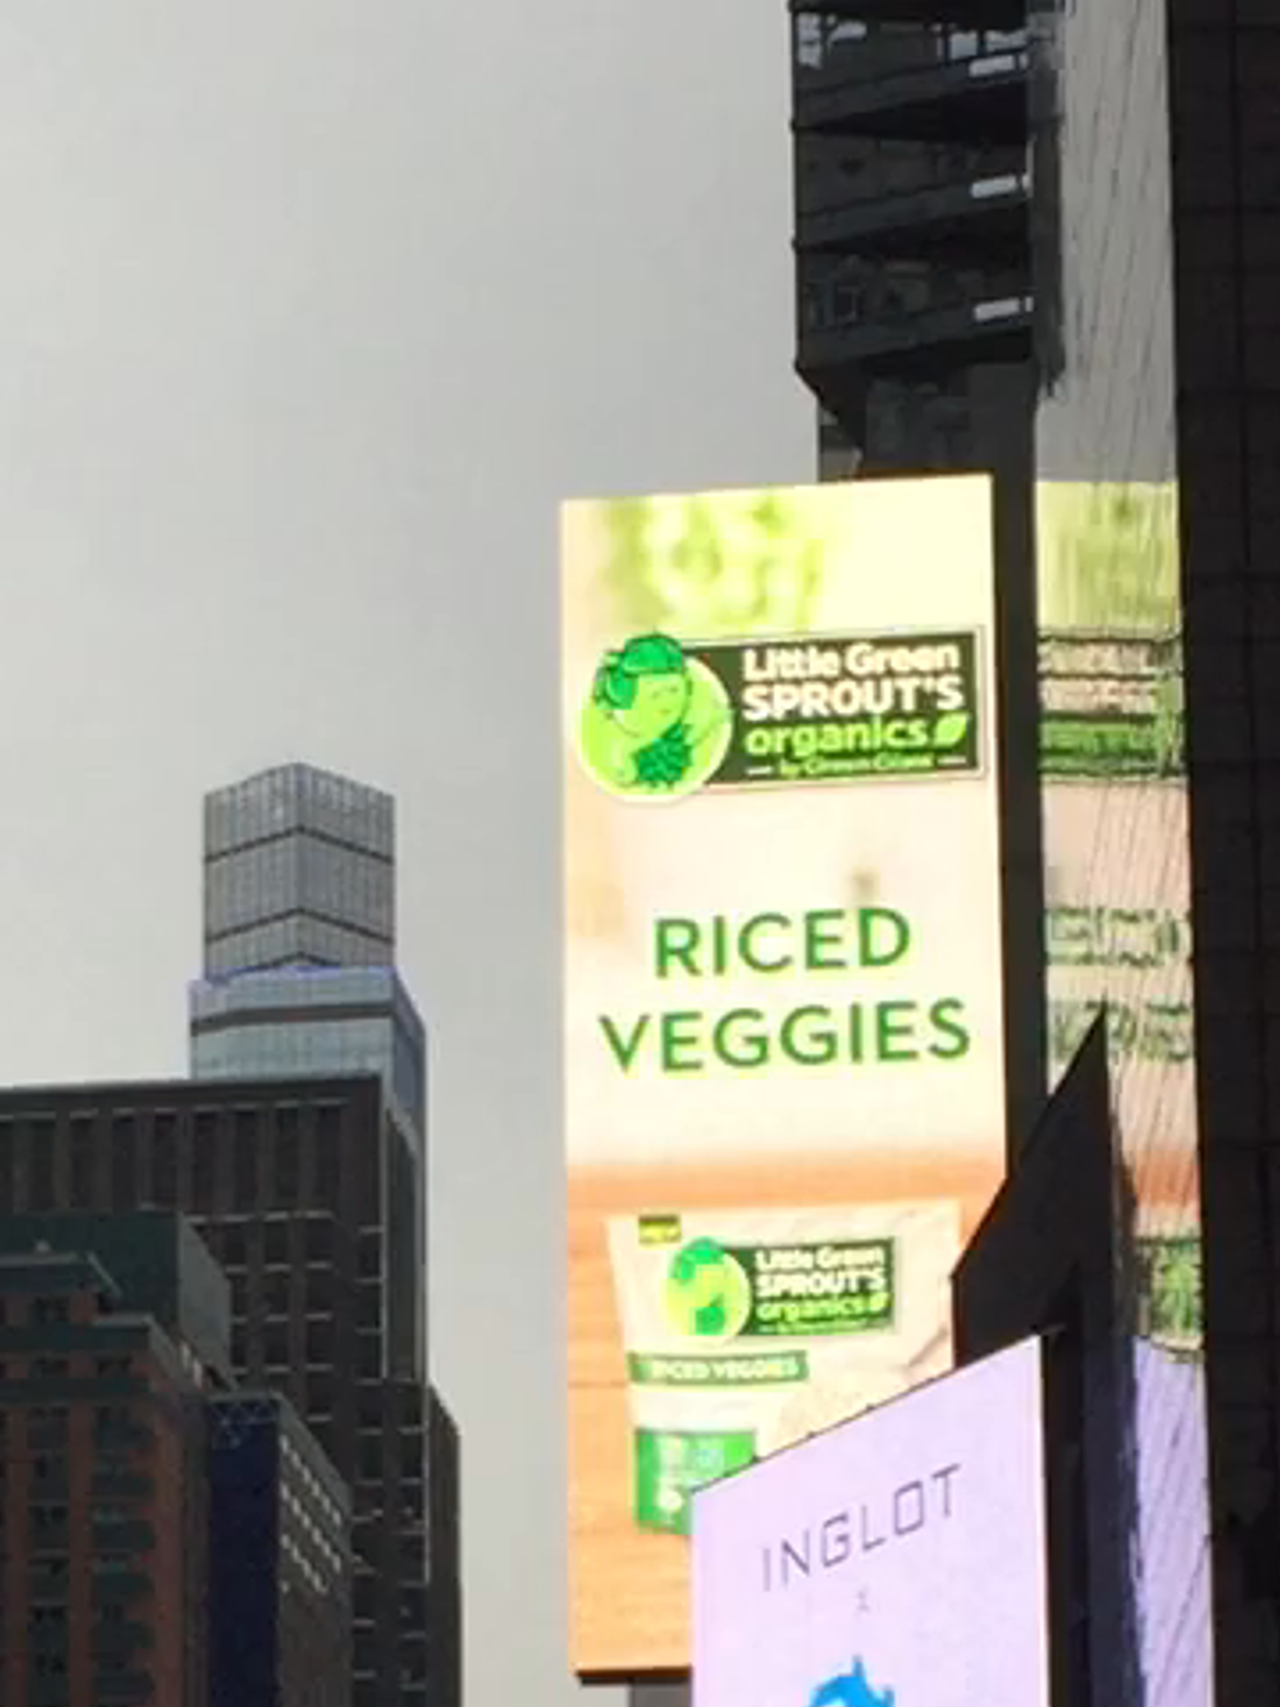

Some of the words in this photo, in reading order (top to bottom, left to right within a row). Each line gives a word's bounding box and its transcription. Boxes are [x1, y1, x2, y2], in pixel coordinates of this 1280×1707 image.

[743, 645, 841, 681] Little
[846, 642, 960, 675] Green
[743, 675, 965, 720] SPROUT'S
[745, 711, 929, 756] organics
[654, 906, 911, 979] RICED
[597, 998, 971, 1074] VEGGIES
[757, 1268, 886, 1298] SPROUT'S
[757, 1295, 867, 1321] organics
[762, 1462, 961, 1592] INGLOT
